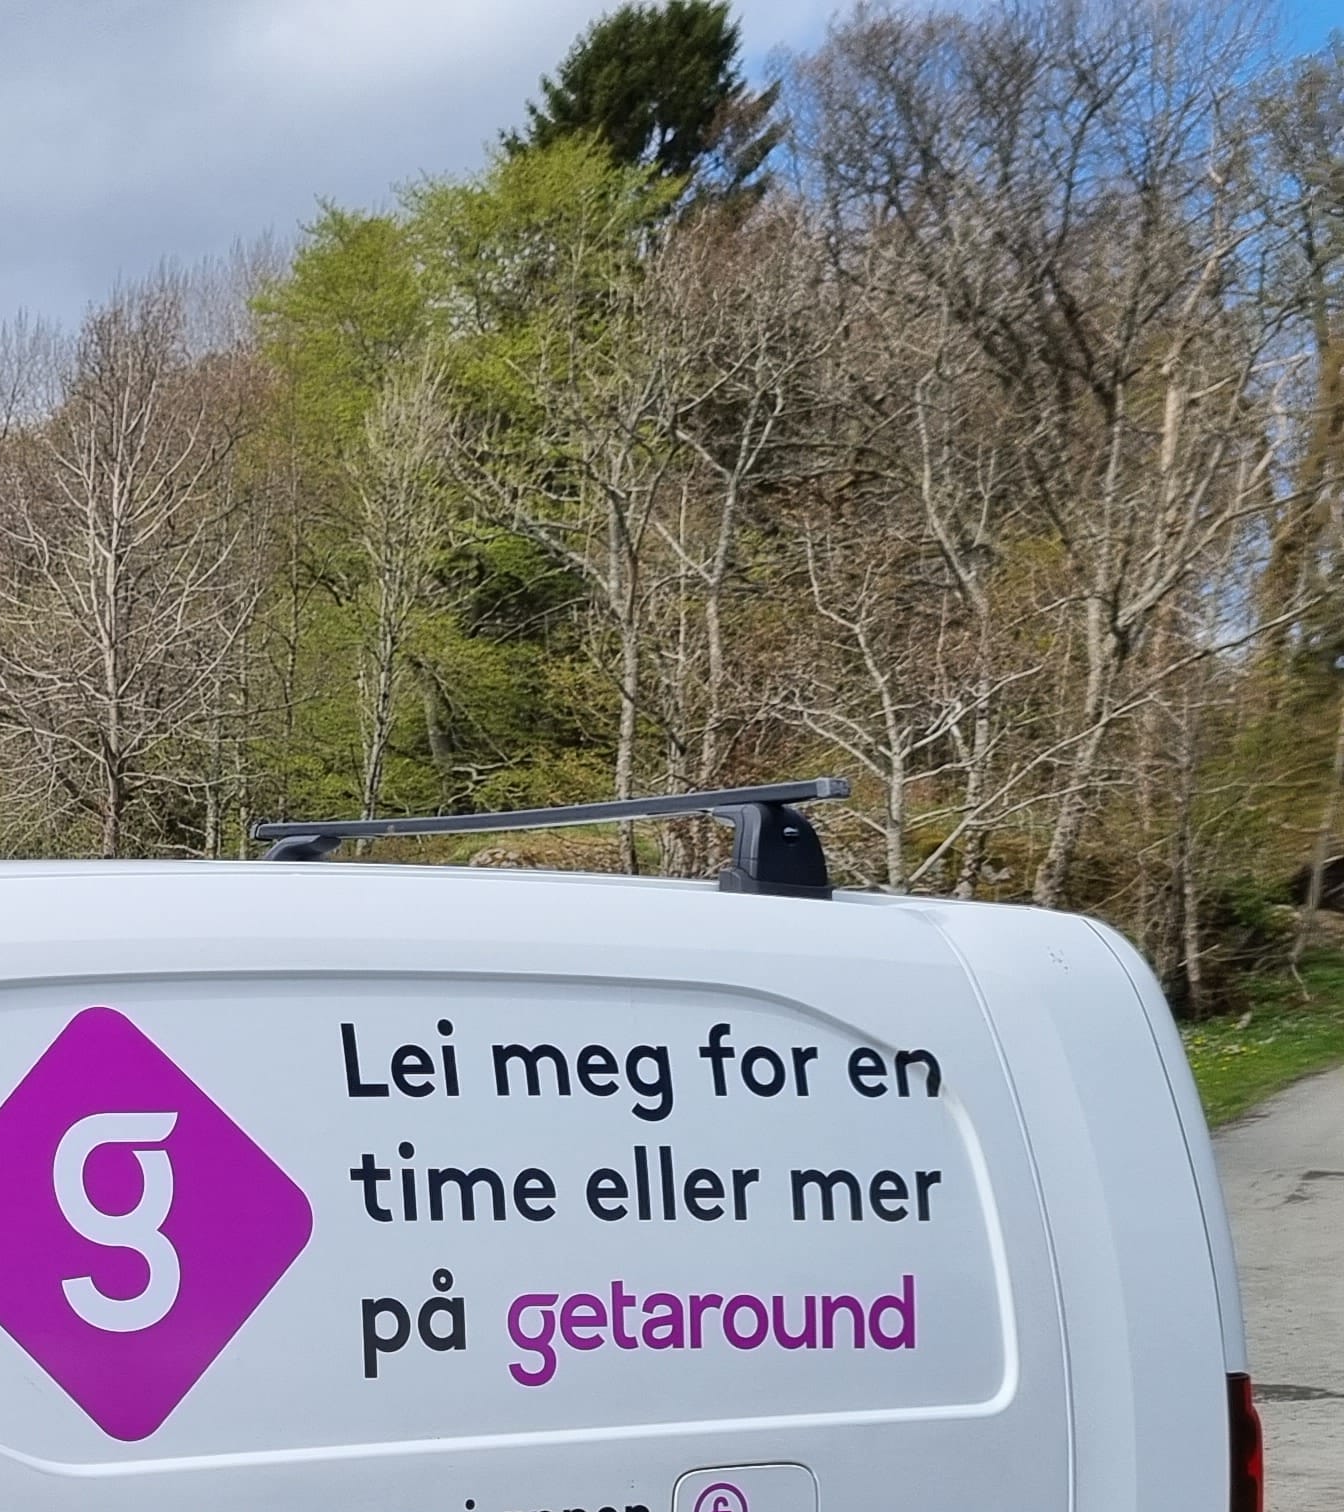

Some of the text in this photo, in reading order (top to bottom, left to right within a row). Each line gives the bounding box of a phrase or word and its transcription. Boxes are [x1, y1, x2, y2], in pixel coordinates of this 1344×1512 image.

[341, 1019, 942, 1122] Lei meg for en
[53, 1112, 180, 1332] g
[350, 1141, 942, 1223] time eller mer
[362, 1267, 916, 1387] på getaround
